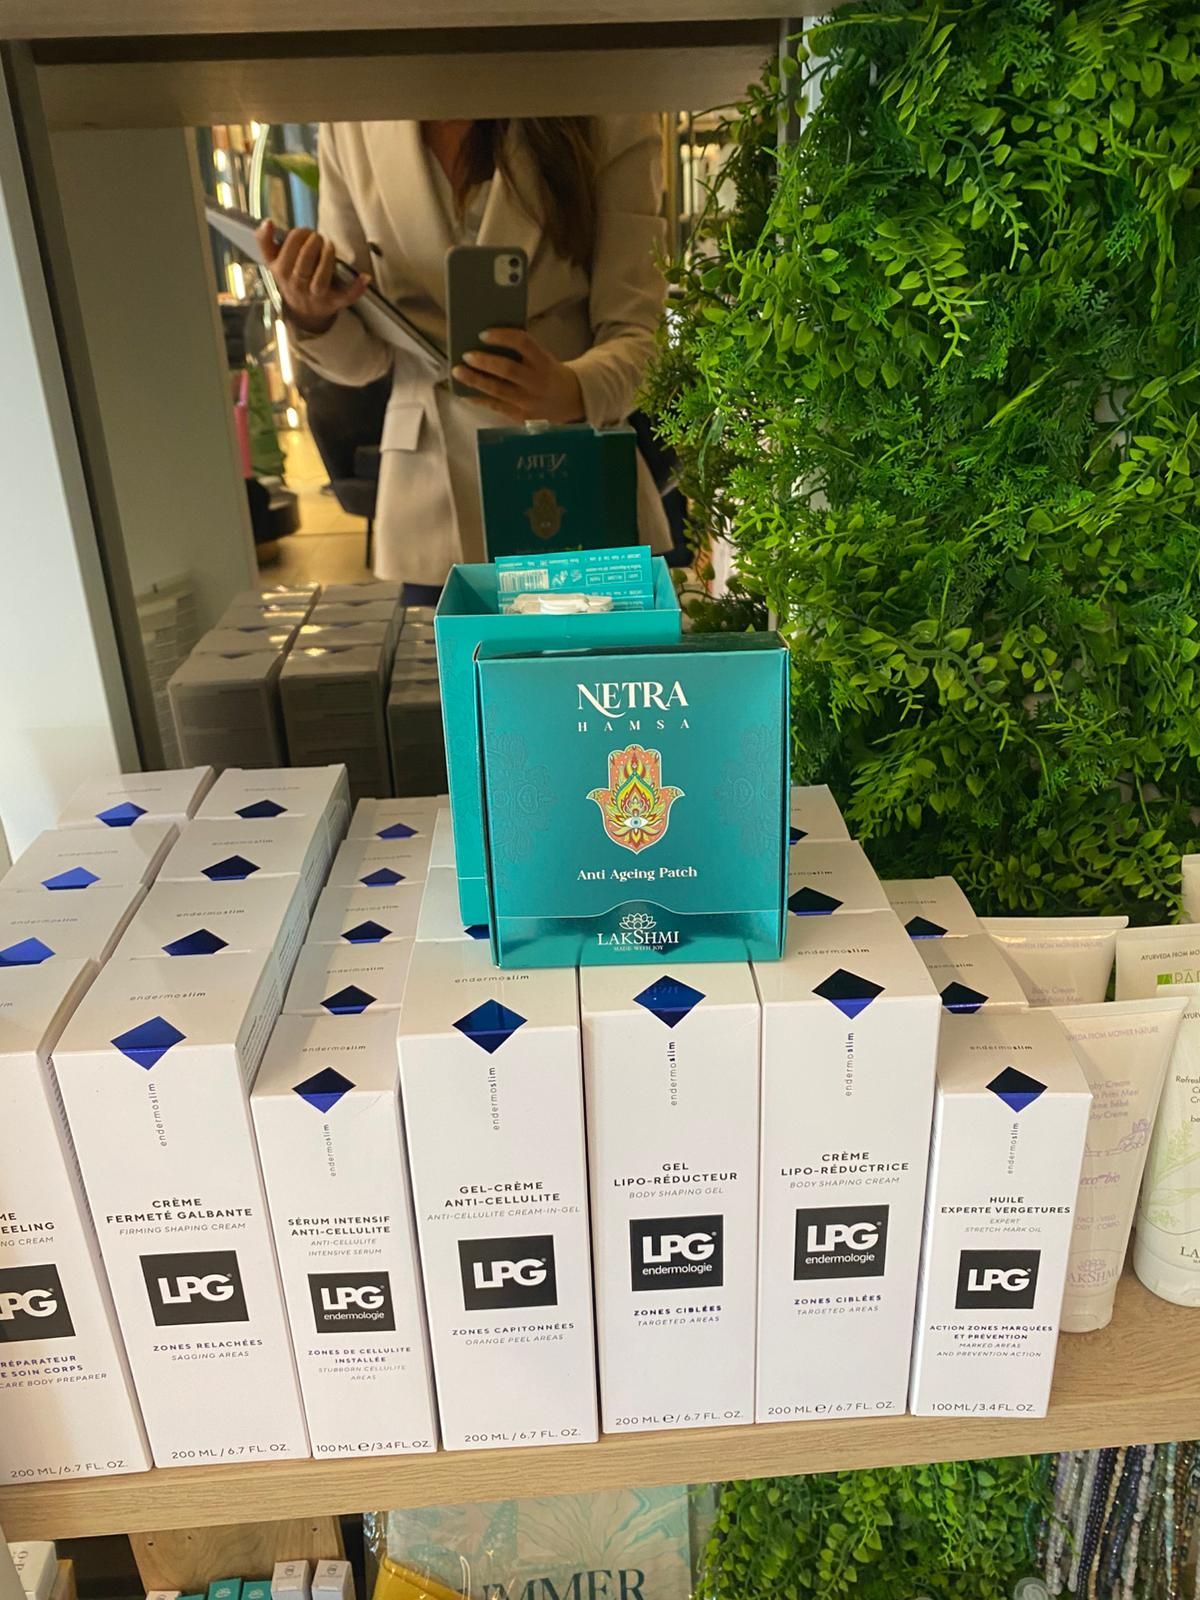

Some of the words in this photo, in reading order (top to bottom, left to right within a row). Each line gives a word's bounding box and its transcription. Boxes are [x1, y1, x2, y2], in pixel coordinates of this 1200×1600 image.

[577, 680, 689, 718] NETRA
[577, 868, 605, 880] Anti
[610, 868, 655, 882] Ageing
[659, 866, 697, 878] Patch
[597, 929, 679, 945] LAKSHMI
[454, 974, 530, 984] endermoslim
[129, 991, 207, 1002] endermoslim
[845, 1032, 855, 1097] endermoslim
[668, 1041, 678, 1106] endermoslim
[488, 1066, 500, 1131] endermoslim
[148, 1083, 168, 1147] endermoslim
[323, 1123, 337, 1177] endermoslim
[1006, 1122, 1019, 1174] endermoslim
[822, 1151, 870, 1162] CRÈME
[662, 1162, 690, 1172] GEL
[781, 1163, 909, 1176] LIPO-RÉDUCTRICE
[614, 1172, 738, 1187] LIPO-RÉDUCTEUR
[819, 1179, 862, 1188] SHAPING
[865, 1177, 900, 1185] CREAM
[459, 1181, 543, 1194] GEL-CRÈME
[629, 1191, 656, 1199] BODY
[658, 1188, 702, 1197] SHAPING
[152, 1197, 203, 1209] CRÈME
[444, 1193, 561, 1207] ANTI-CELLULITE
[989, 1196, 1024, 1204] HUILE
[106, 1209, 173, 1224] FERMETÉ
[177, 1208, 253, 1220] GALBANTE
[427, 1210, 505, 1221] ANTI-CELLULITE
[507, 1206, 581, 1217] CREAM-IN-GEL
[941, 1206, 992, 1214] EXPERTE
[995, 1206, 1071, 1214] VERGETURES
[288, 1216, 330, 1226] SÉRUM
[334, 1215, 391, 1224] INTENSIF
[119, 1226, 163, 1236] FIRMING
[164, 1224, 208, 1233] SHAPING
[211, 1222, 246, 1231] CREAM
[291, 1226, 391, 1237] ANTI-CELLULITE
[18, 1236, 54, 1247] CREAM
[311, 1238, 378, 1247] ANTI-CELLULITE
[807, 1222, 879, 1253] LPG
[308, 1249, 351, 1257] INTENSIVE
[353, 1248, 382, 1256] SERUM
[642, 1232, 715, 1264] LPG
[805, 1252, 875, 1265] endermologie
[473, 1258, 547, 1289] LPG
[642, 1262, 713, 1276] endermologie
[967, 1268, 1031, 1291] LPG
[157, 1273, 235, 1304] LPG
[320, 1285, 385, 1311] LPG
[794, 1297, 831, 1305] ZONES
[835, 1293, 882, 1304] CIBLÉES
[324, 1310, 385, 1321] endermologie
[634, 1308, 672, 1316] ZONES
[675, 1304, 723, 1314] CIBLÉES
[797, 1307, 846, 1316] TARGETED
[848, 1305, 880, 1313] AREAS
[637, 1318, 686, 1327] TARGETED
[688, 1316, 720, 1324] AREAS
[1001, 1324, 1053, 1332] MARQUÉES
[452, 1327, 490, 1336] ZONES
[494, 1322, 575, 1334] CAPITONNÉES
[153, 1343, 192, 1352] ZONES
[196, 1338, 264, 1349] RELACHÉES
[465, 1338, 506, 1346] ORANGE
[507, 1335, 531, 1344] PEEL
[533, 1334, 564, 1342] AREAS
[171, 1352, 217, 1362] SAGGING
[218, 1350, 251, 1359] AREAS
[308, 1348, 341, 1356] ZONES
[358, 1346, 412, 1355] CELLULITE
[1, 1354, 78, 1369] RÉPARATEUR
[334, 1356, 387, 1365] INSTALLÉE
[11, 1368, 41, 1378] SOIN
[44, 1364, 85, 1375] CORPS
[27, 1377, 56, 1387] BODY
[57, 1372, 108, 1384] PREPARER
[767, 1406, 792, 1416] 200
[794, 1405, 813, 1415] ML
[835, 1402, 853, 1412] 6.7
[855, 1401, 874, 1411] FL.
[875, 1400, 895, 1410] OZ.
[932, 1403, 953, 1412] 100
[998, 1403, 1015, 1412] FL.
[1016, 1403, 1036, 1413] OZ.
[615, 1416, 640, 1426] 200
[642, 1415, 661, 1425] ML
[683, 1412, 701, 1422] 6.7
[703, 1411, 721, 1421] FL.
[723, 1410, 744, 1419] OZ.
[464, 1433, 489, 1443] 200
[491, 1432, 510, 1441] ML
[519, 1430, 537, 1440] 6.7
[540, 1429, 558, 1438] FL.
[560, 1427, 581, 1437] OZ.
[171, 1450, 197, 1460] 200
[198, 1447, 218, 1457] ML
[227, 1445, 246, 1456] 6.7
[248, 1444, 267, 1453] FL.
[268, 1443, 291, 1452] OZ.
[315, 1443, 337, 1453] 100
[338, 1442, 357, 1452] ML
[411, 1440, 432, 1449] OZ.
[10, 1468, 35, 1479] 200
[85, 1460, 105, 1471] FL.
[105, 1459, 129, 1470] OZ.
